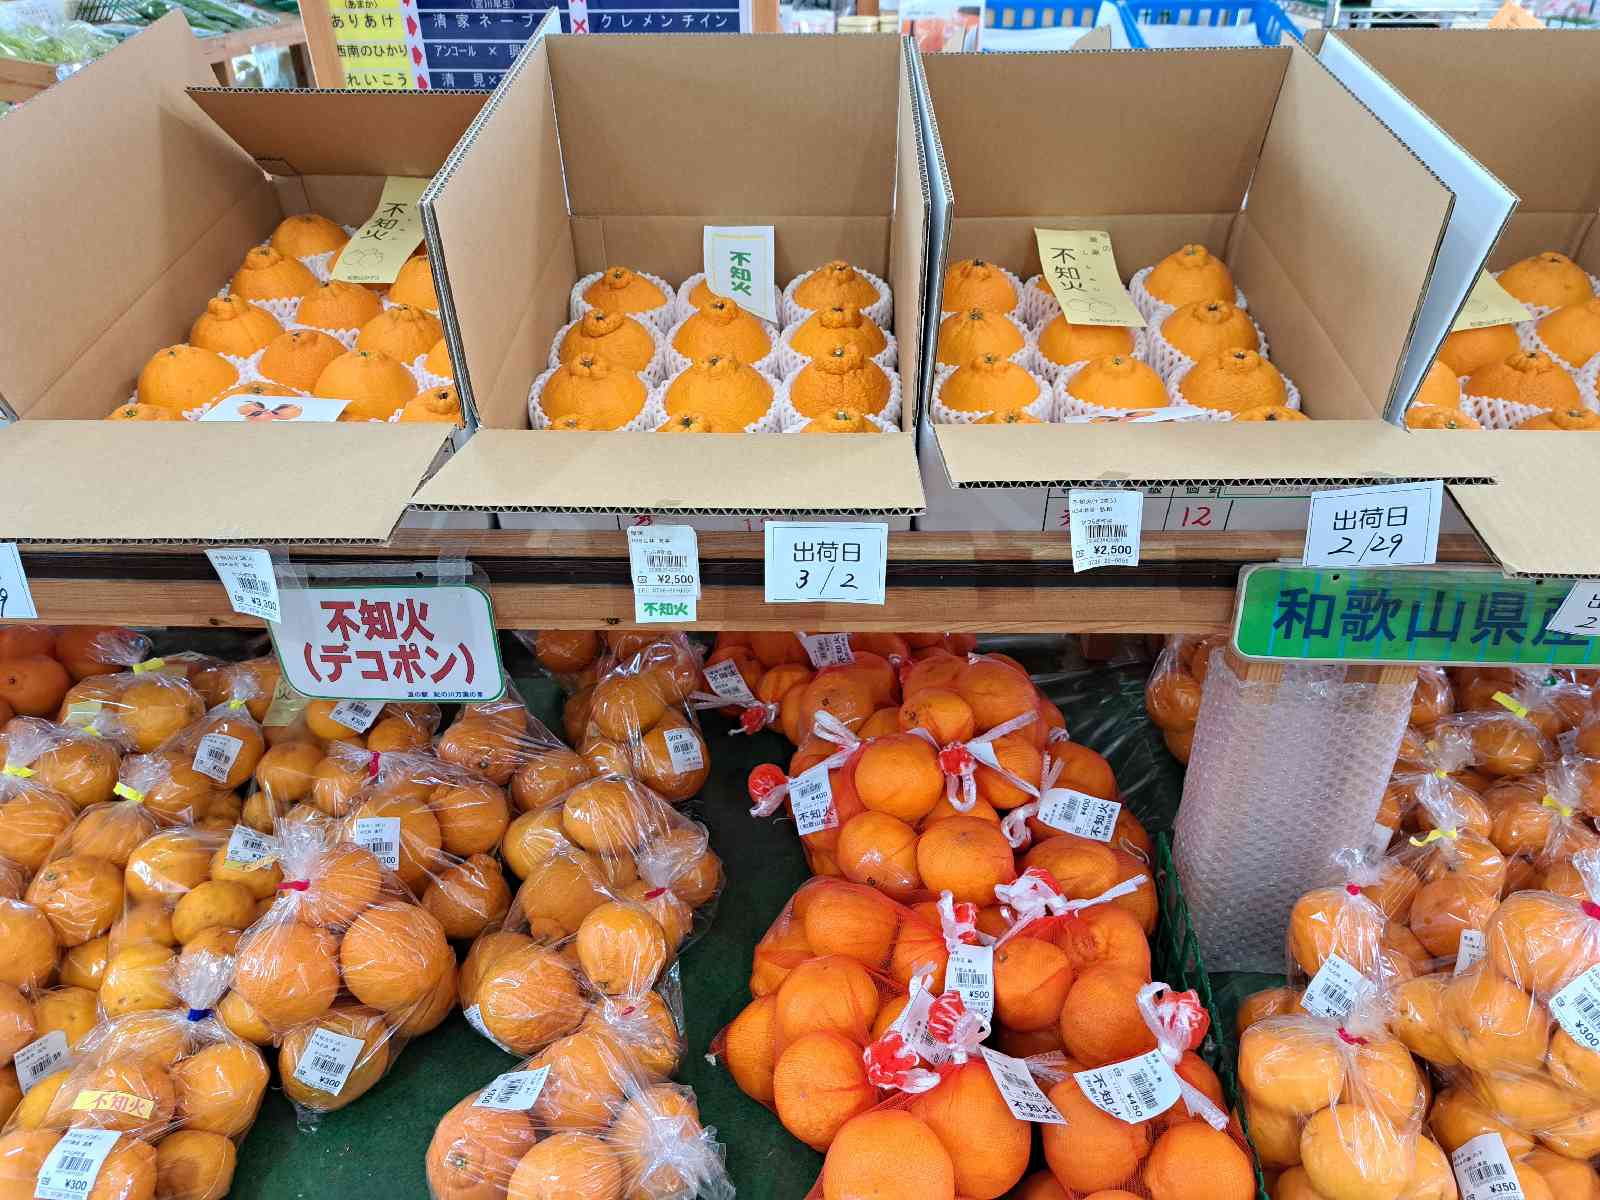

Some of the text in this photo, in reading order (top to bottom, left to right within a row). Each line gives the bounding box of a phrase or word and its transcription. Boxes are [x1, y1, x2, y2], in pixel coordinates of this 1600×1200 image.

[331, 13, 394, 29] ありあけ
[337, 44, 408, 58] 西南のひかり
[434, 45, 477, 57] アンコール
[347, 72, 407, 87] れいこう
[360, 202, 408, 241] 不知火
[729, 250, 752, 297] 不知火
[1050, 247, 1088, 293] 不知火
[1183, 506, 1211, 527] 12
[1333, 506, 1408, 531] 出荷日
[793, 540, 861, 562] 出荷日
[1094, 545, 1132, 556] ¥2,500
[1328, 533, 1403, 562] 2/29
[657, 574, 694, 585] ¥2,500
[251, 596, 277, 611] ¥3,300
[643, 602, 689, 616] 不知火
[320, 598, 435, 641] 不知火
[303, 642, 476, 685] (デコポン)
[1080, 798, 1091, 816] ¥400
[1091, 802, 1110, 837] 不知火
[969, 990, 990, 999] ¥500
[1575, 1020, 1600, 1047] ¥300
[320, 1076, 340, 1088] ¥300
[94, 1094, 146, 1115] 不知火
[1011, 1099, 1057, 1113] 不知火
[1127, 1093, 1143, 1117] ¥450
[65, 1179, 88, 1191] ¥300
[1490, 1182, 1517, 1194] ¥350
